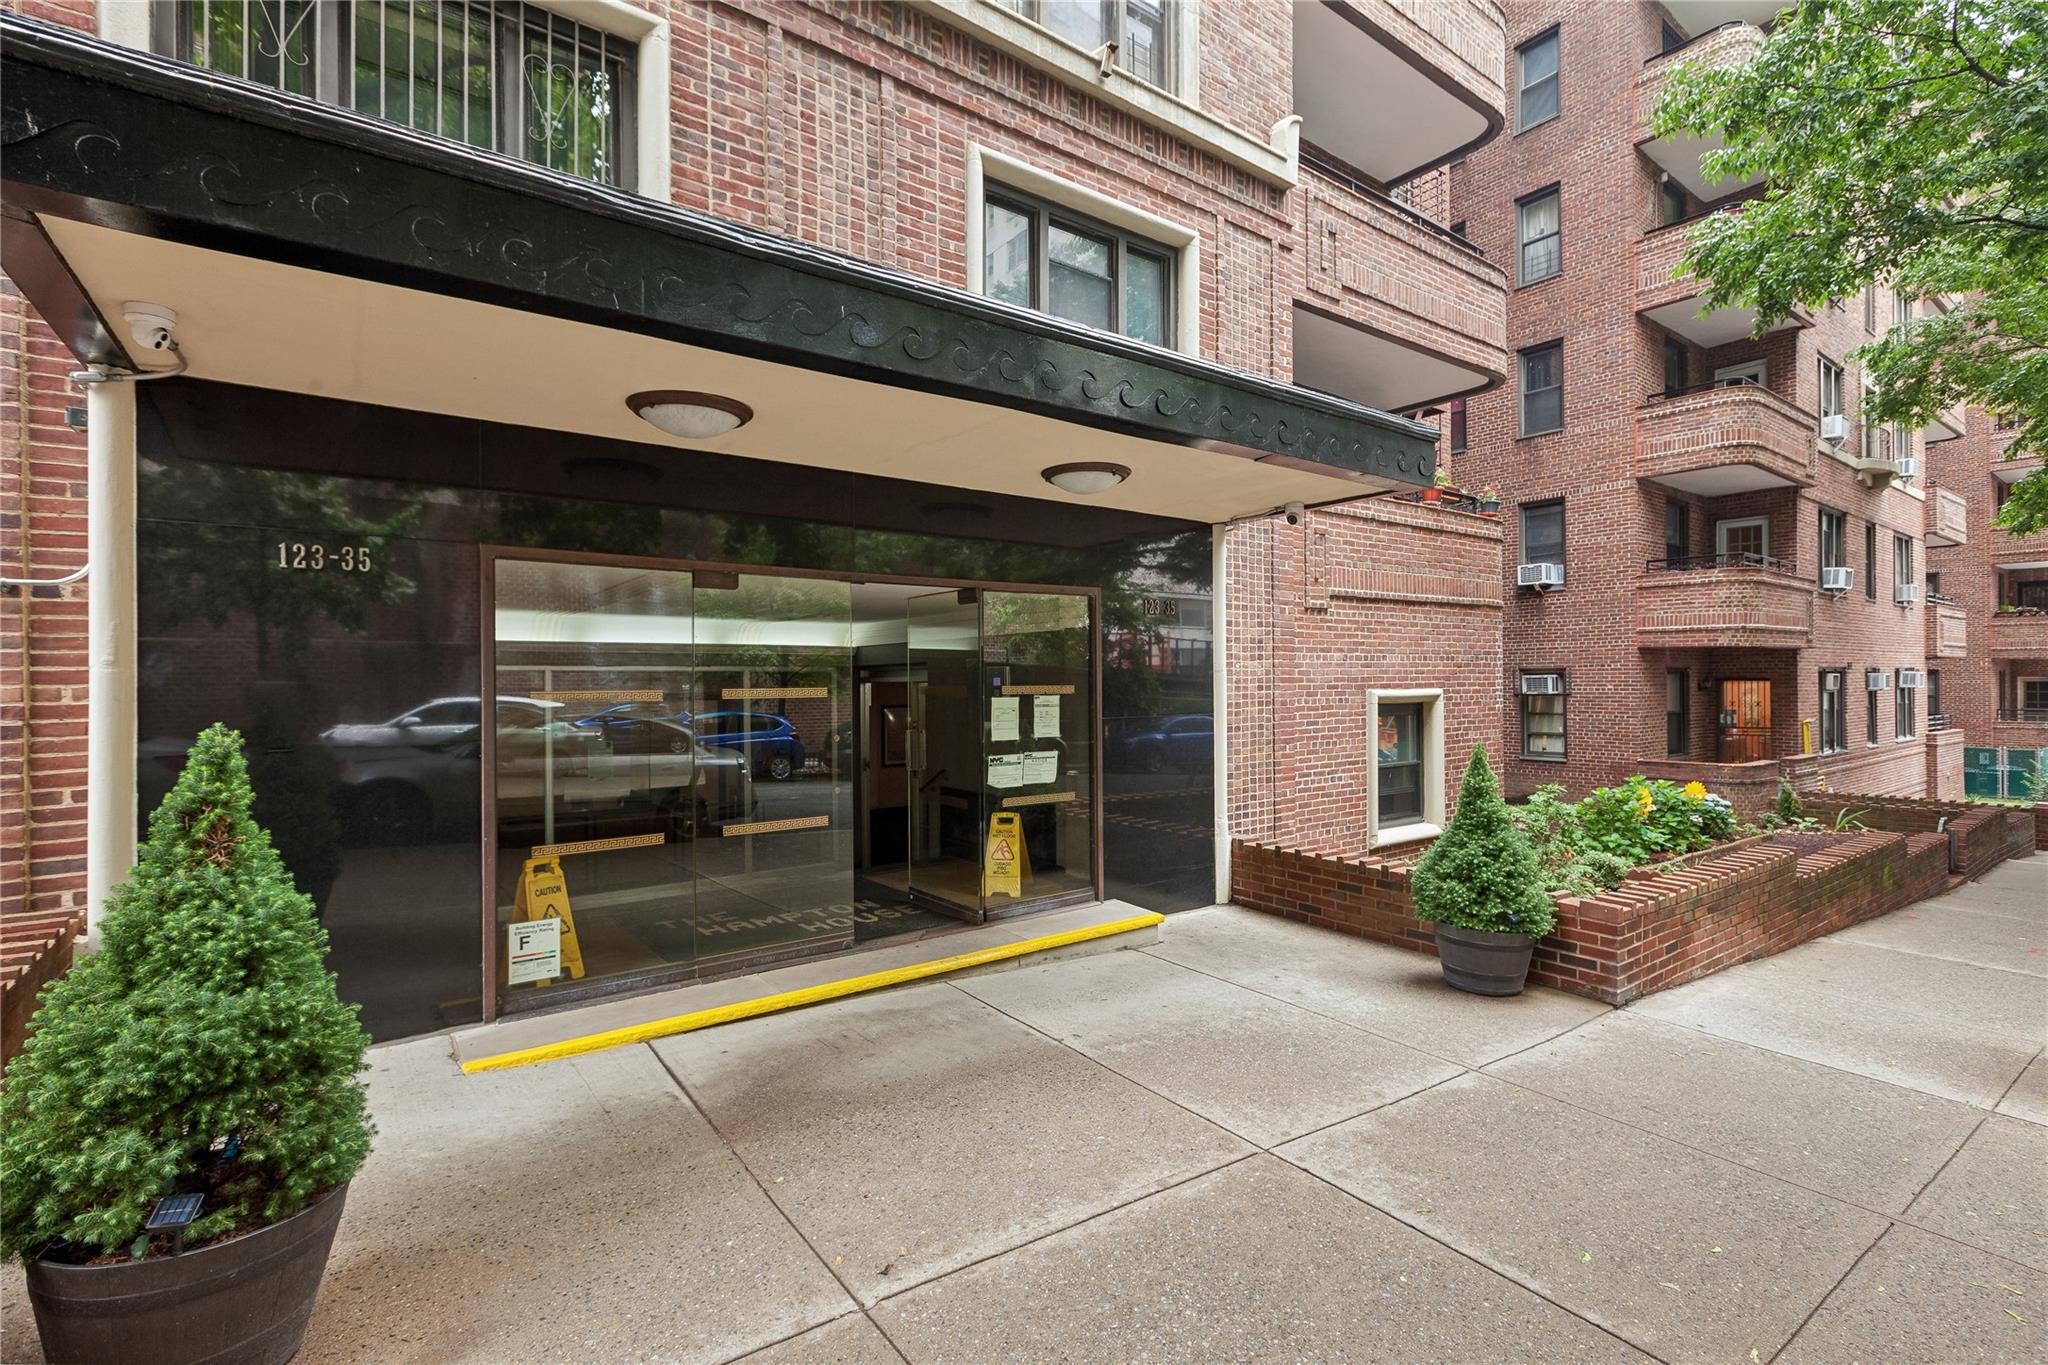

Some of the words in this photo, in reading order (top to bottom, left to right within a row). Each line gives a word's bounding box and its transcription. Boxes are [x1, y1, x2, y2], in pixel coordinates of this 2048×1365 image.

[278, 542, 371, 572] 123-35
[989, 756, 1004, 764] NYC
[534, 885, 562, 898] CAUTION
[655, 911, 737, 929] THE
[697, 899, 882, 936] HAMPTON
[797, 904, 926, 932] HOUSE
[519, 935, 531, 951] F
